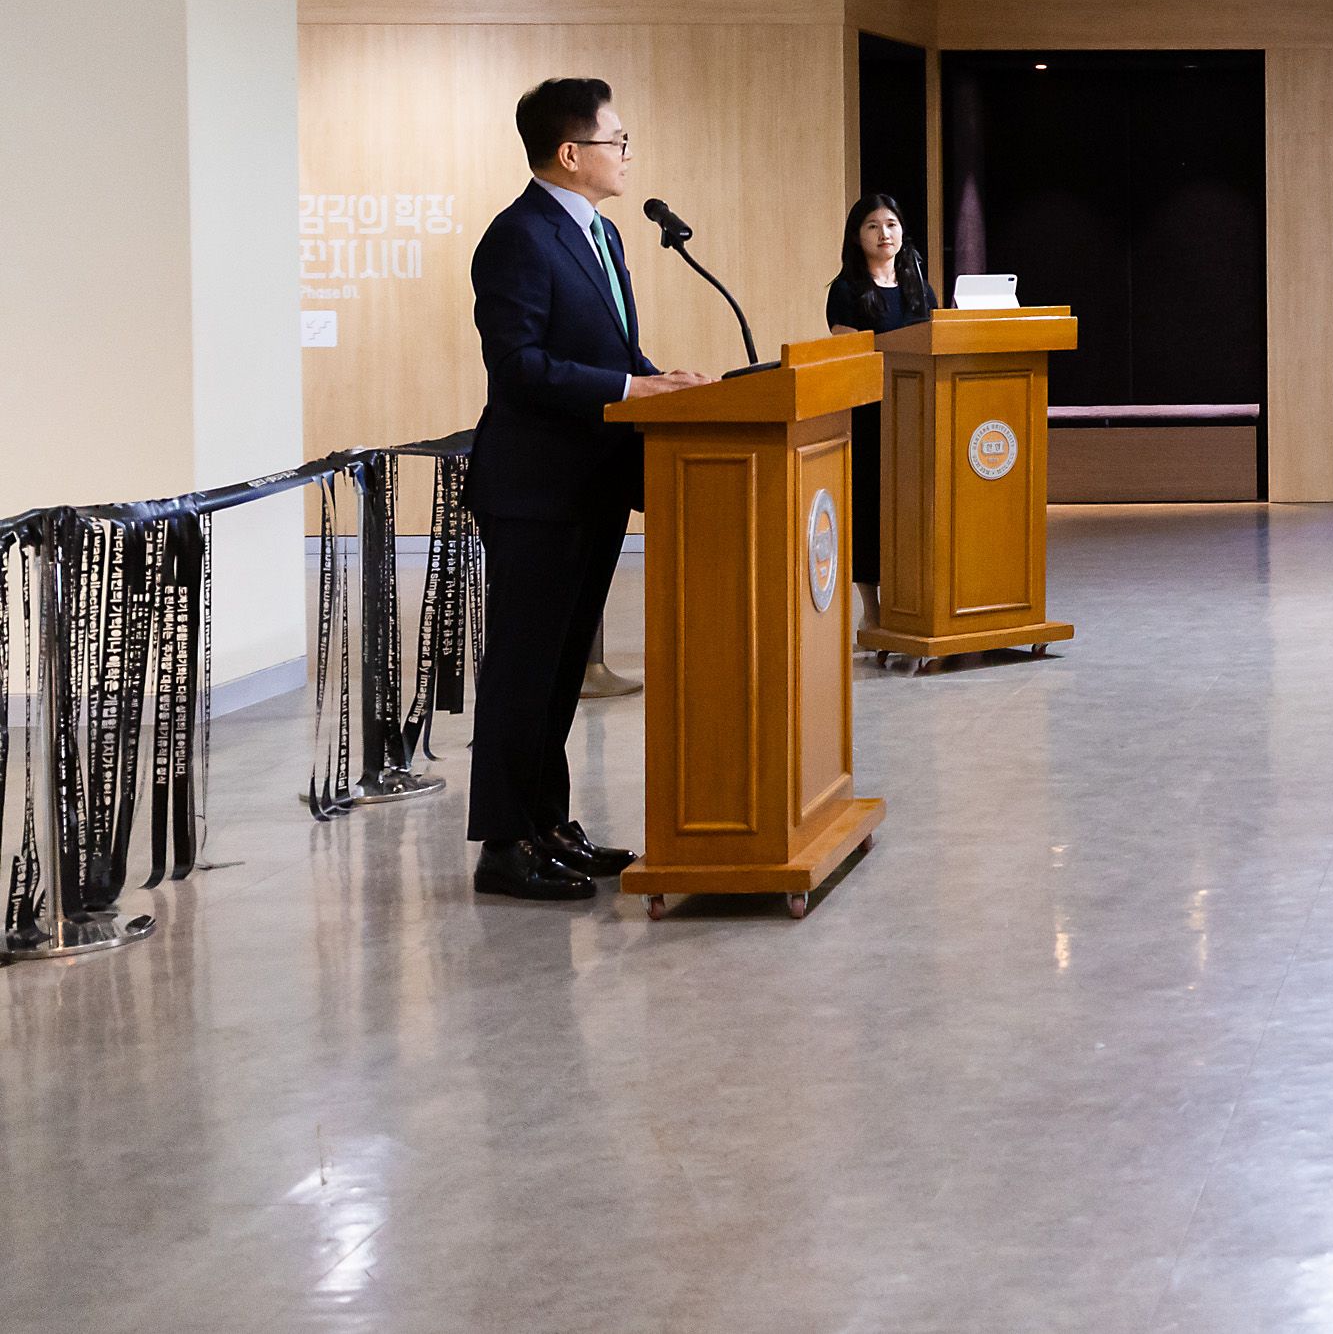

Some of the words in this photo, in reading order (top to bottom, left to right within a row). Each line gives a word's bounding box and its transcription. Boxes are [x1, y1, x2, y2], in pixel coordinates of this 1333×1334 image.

[395, 194, 463, 234] 확장,
[433, 506, 444, 538] things
[433, 539, 444, 553] do
[431, 555, 442, 572] not
[110, 567, 123, 603] 개인의
[426, 573, 440, 604] simply
[88, 564, 101, 640] collectively
[162, 596, 175, 639] 전시에서는
[107, 605, 122, 654] 기억이나
[421, 605, 436, 658] disappear.
[89, 642, 99, 690] buried.
[419, 660, 432, 674] By
[159, 675, 172, 692] 대신
[175, 686, 188, 703] 다른
[409, 674, 430, 724] imagining
[341, 694, 349, 712] but
[340, 714, 348, 747] under
[102, 732, 116, 768] 여지가
[337, 757, 347, 790] social
